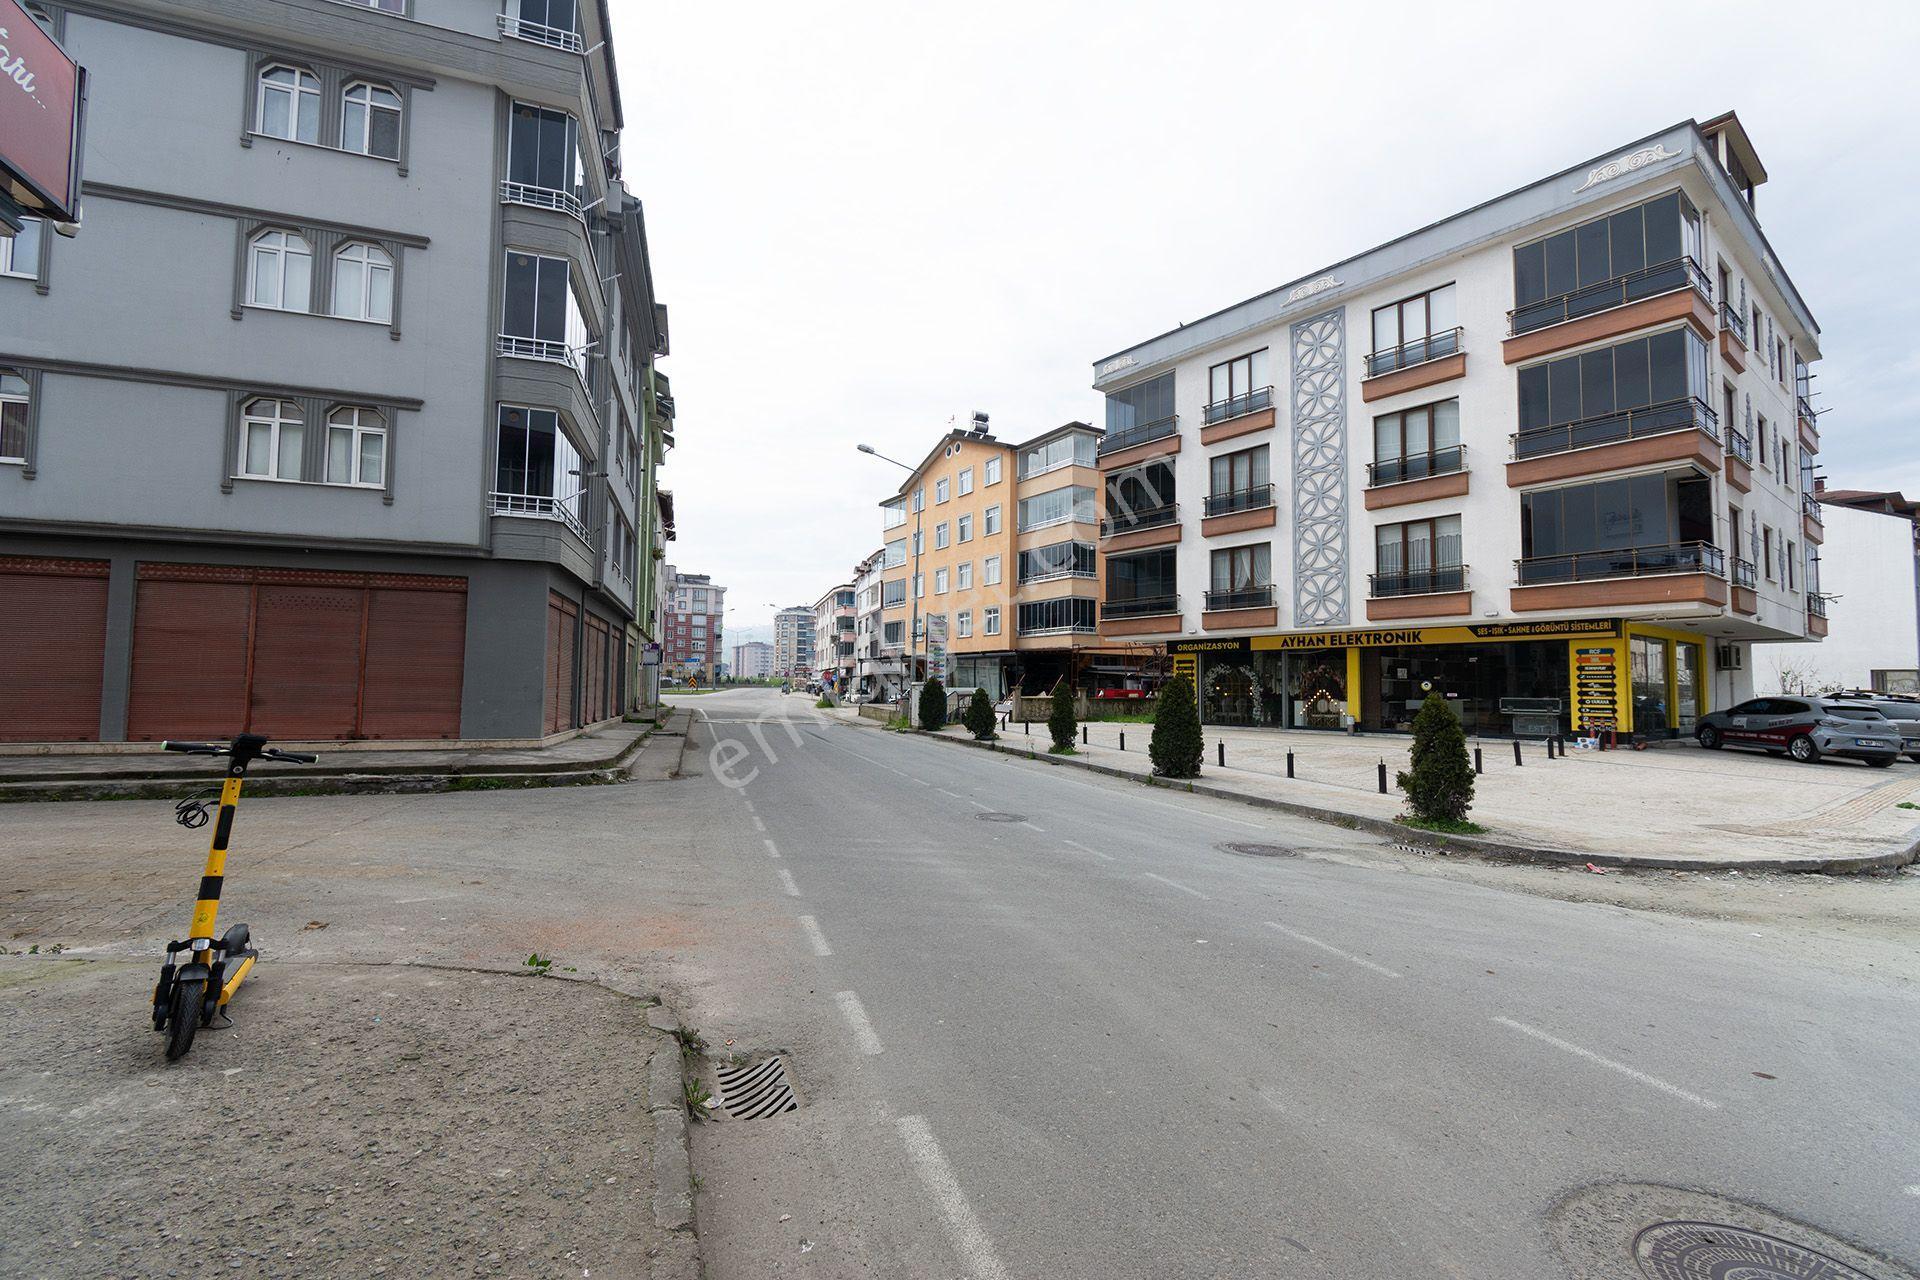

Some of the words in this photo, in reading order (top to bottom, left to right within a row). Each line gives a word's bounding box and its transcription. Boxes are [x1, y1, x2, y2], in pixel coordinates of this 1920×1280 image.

[1508, 625, 1530, 634] SAHNE
[1177, 641, 1240, 651] ORGANİZASYON
[1281, 635, 1325, 648] AYHAN
